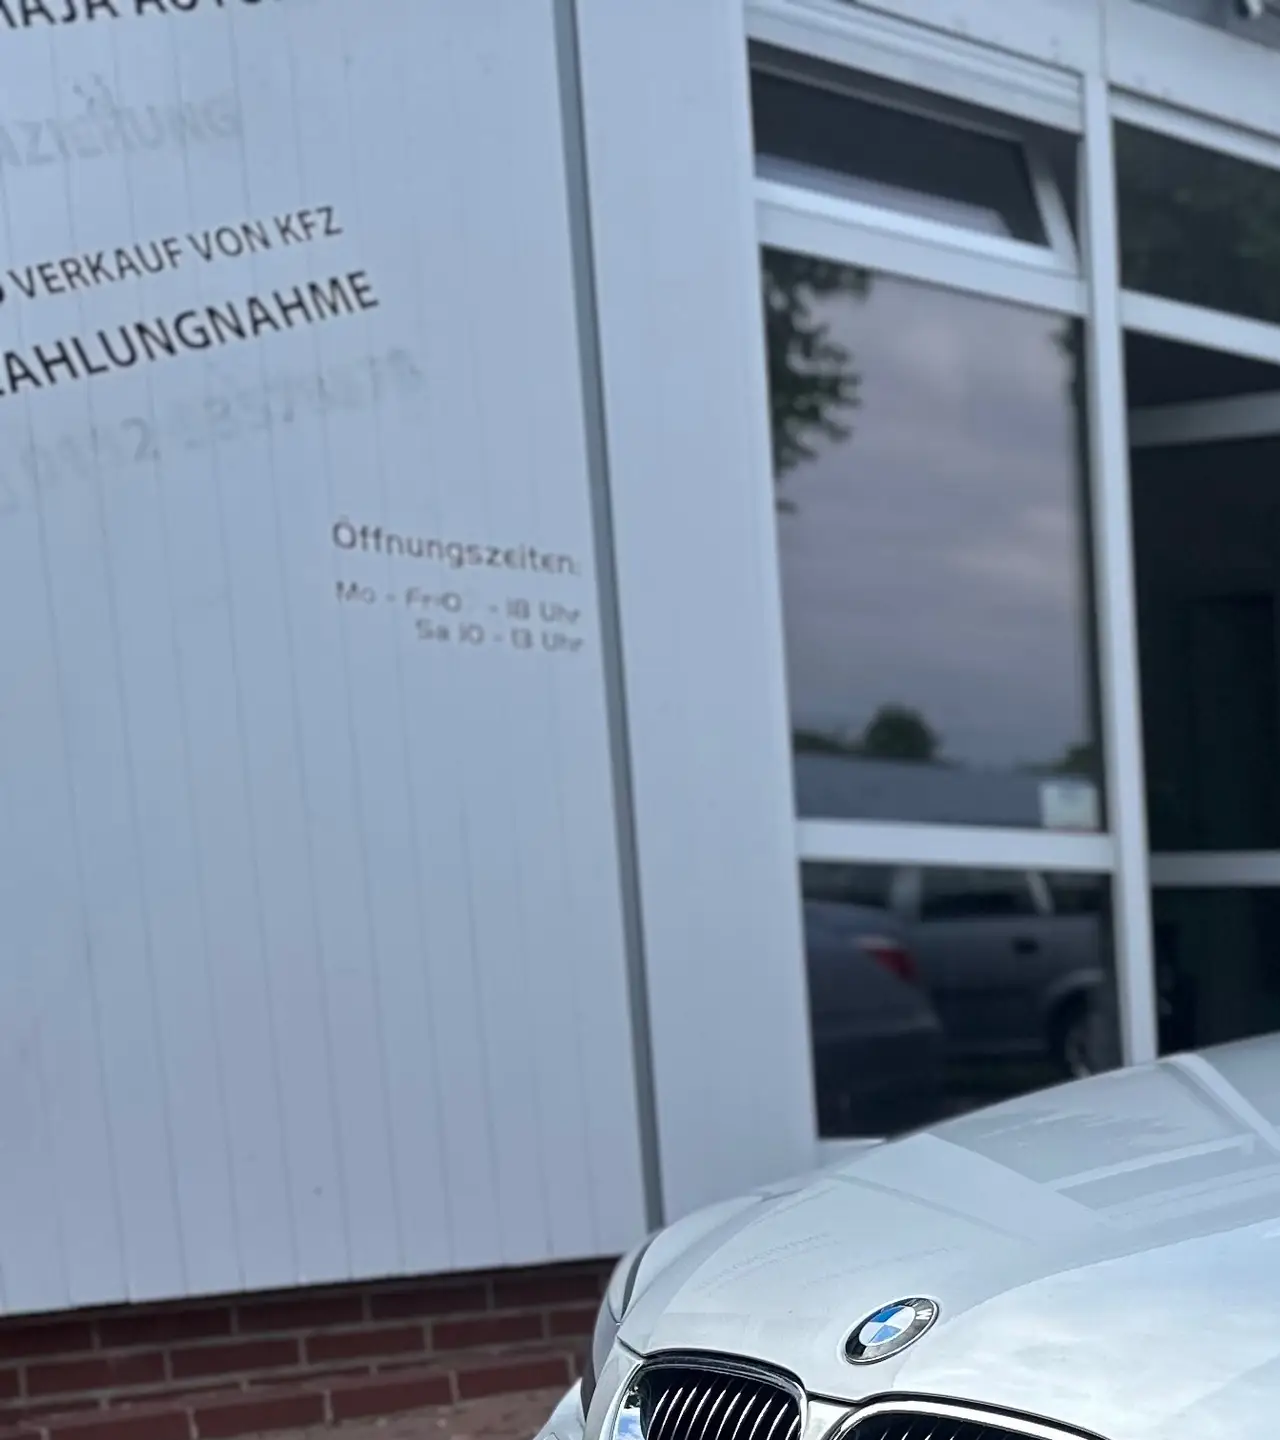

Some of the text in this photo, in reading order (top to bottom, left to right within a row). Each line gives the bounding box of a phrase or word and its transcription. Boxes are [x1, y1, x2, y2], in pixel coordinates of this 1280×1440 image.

[7, 237, 183, 299] VERKAUF
[186, 220, 271, 263] VON
[273, 206, 343, 246] KFZ
[0, 271, 379, 396] AHLUNGNAHME
